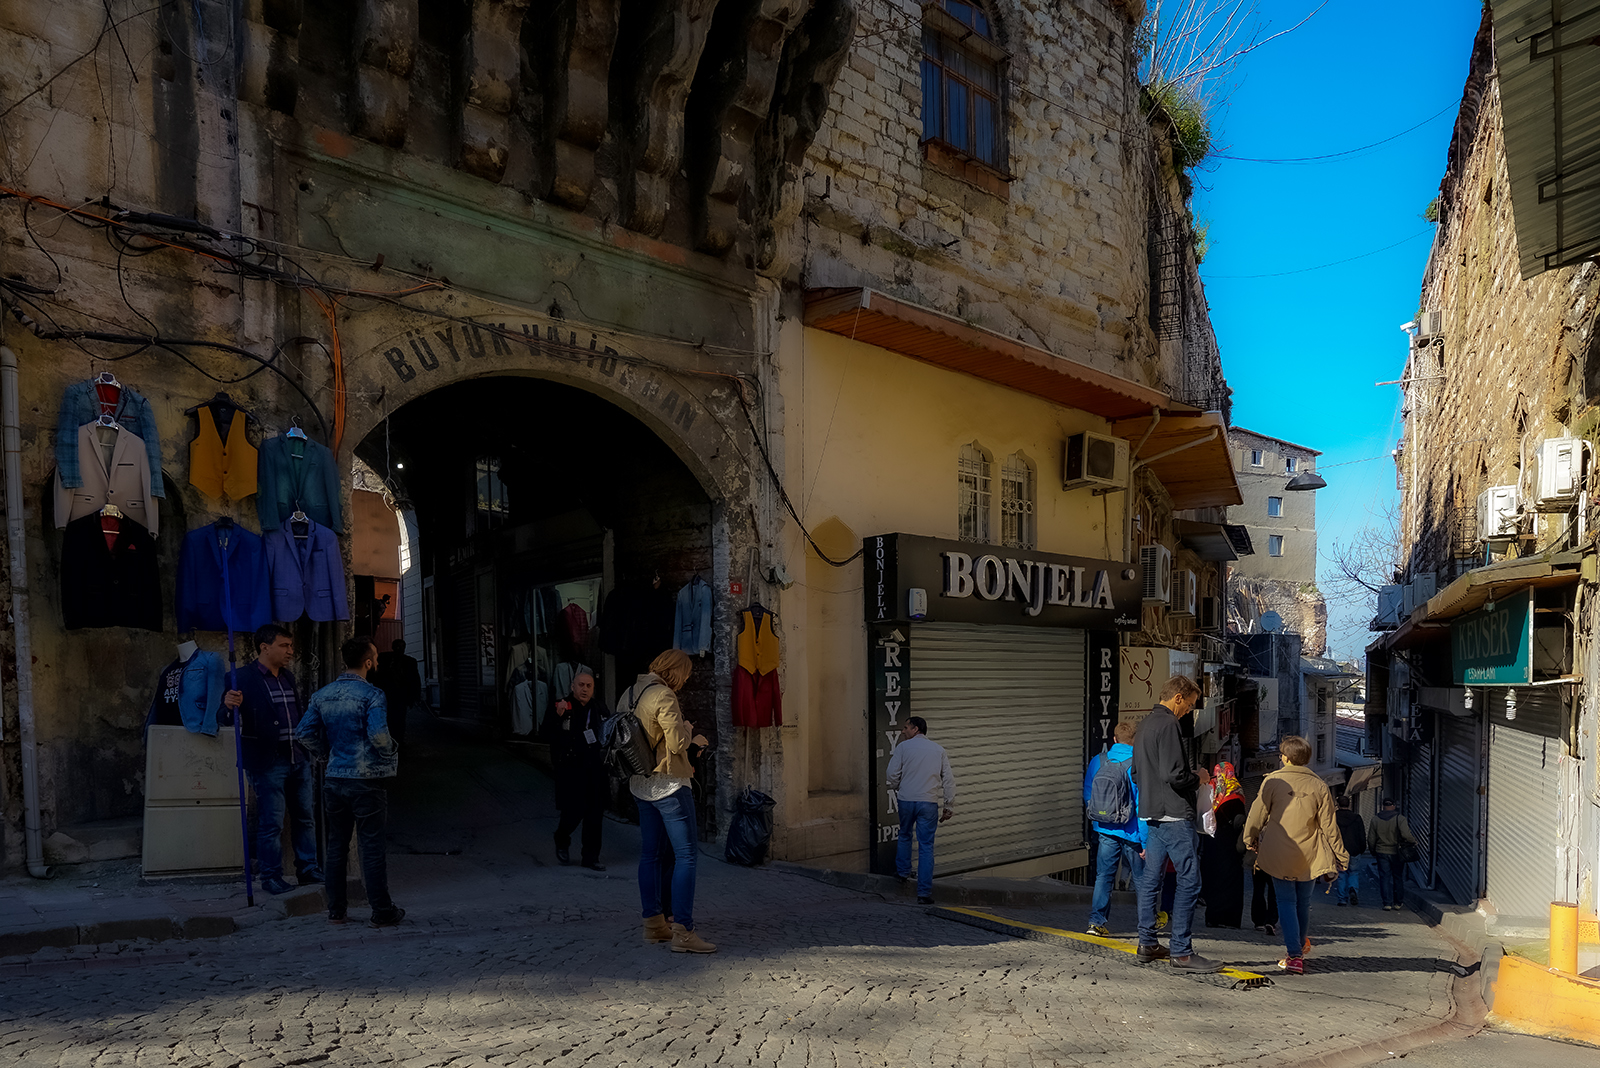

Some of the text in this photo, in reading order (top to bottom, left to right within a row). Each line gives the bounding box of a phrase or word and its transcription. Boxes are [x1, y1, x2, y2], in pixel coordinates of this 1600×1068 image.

[875, 536, 885, 619] BONJELA
[941, 550, 1115, 617] BONJELA
[1458, 609, 1511, 660] KEVSER
[884, 642, 903, 814] REYYN
